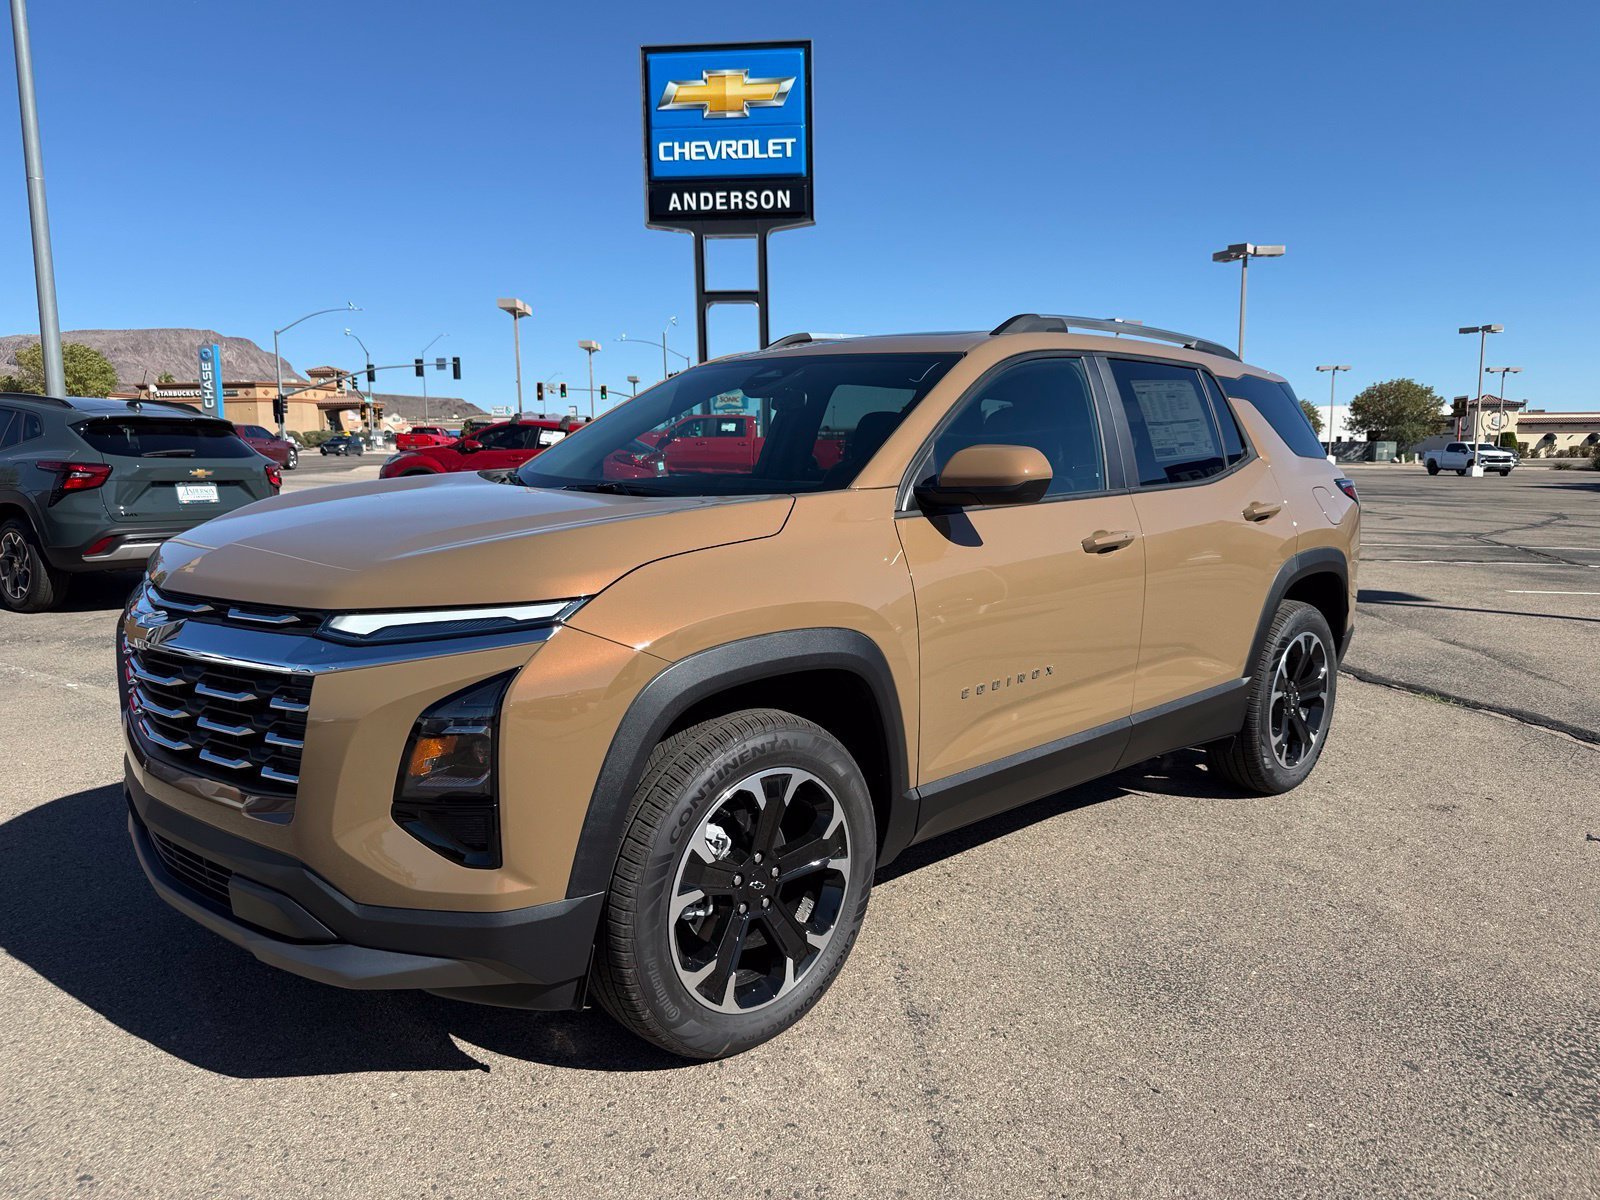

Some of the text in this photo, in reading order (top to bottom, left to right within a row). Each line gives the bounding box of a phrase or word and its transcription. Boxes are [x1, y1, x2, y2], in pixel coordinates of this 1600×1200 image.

[658, 138, 796, 161] CHEVROLET
[669, 190, 790, 211] ANDERSON
[202, 362, 214, 408] CHASE
[961, 665, 1054, 699] EQUINOX
[669, 738, 804, 844] CONTINENTAL
[643, 952, 680, 1021] Continental
